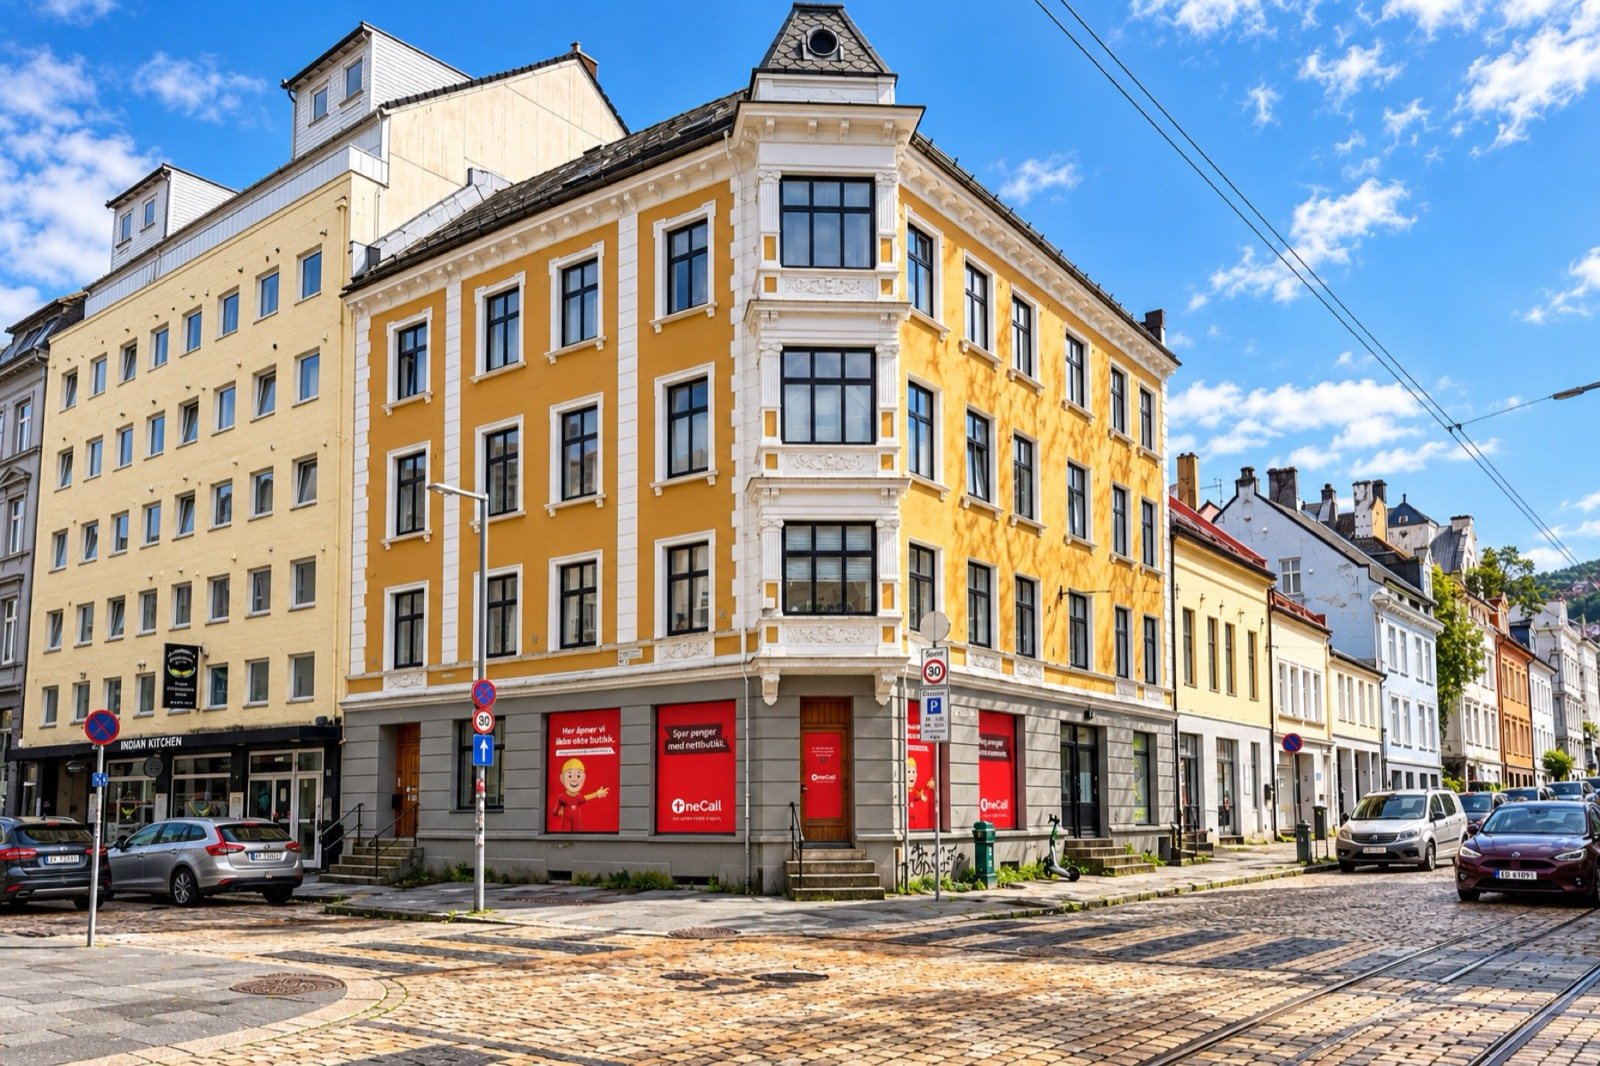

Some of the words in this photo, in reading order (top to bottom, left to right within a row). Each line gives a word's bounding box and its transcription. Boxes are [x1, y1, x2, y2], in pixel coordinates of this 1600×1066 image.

[928, 665, 941, 677] 30
[931, 700, 939, 712] P
[478, 715, 490, 727] 30
[576, 726, 598, 736] åpner
[598, 724, 606, 733] vi
[672, 729, 689, 739] Spar
[690, 728, 716, 739] penger
[120, 740, 147, 750] INDIAN
[148, 737, 182, 748] KITCHEN
[667, 741, 685, 750] med
[685, 738, 726, 749] nettbutikk.
[672, 798, 722, 814] OneCall
